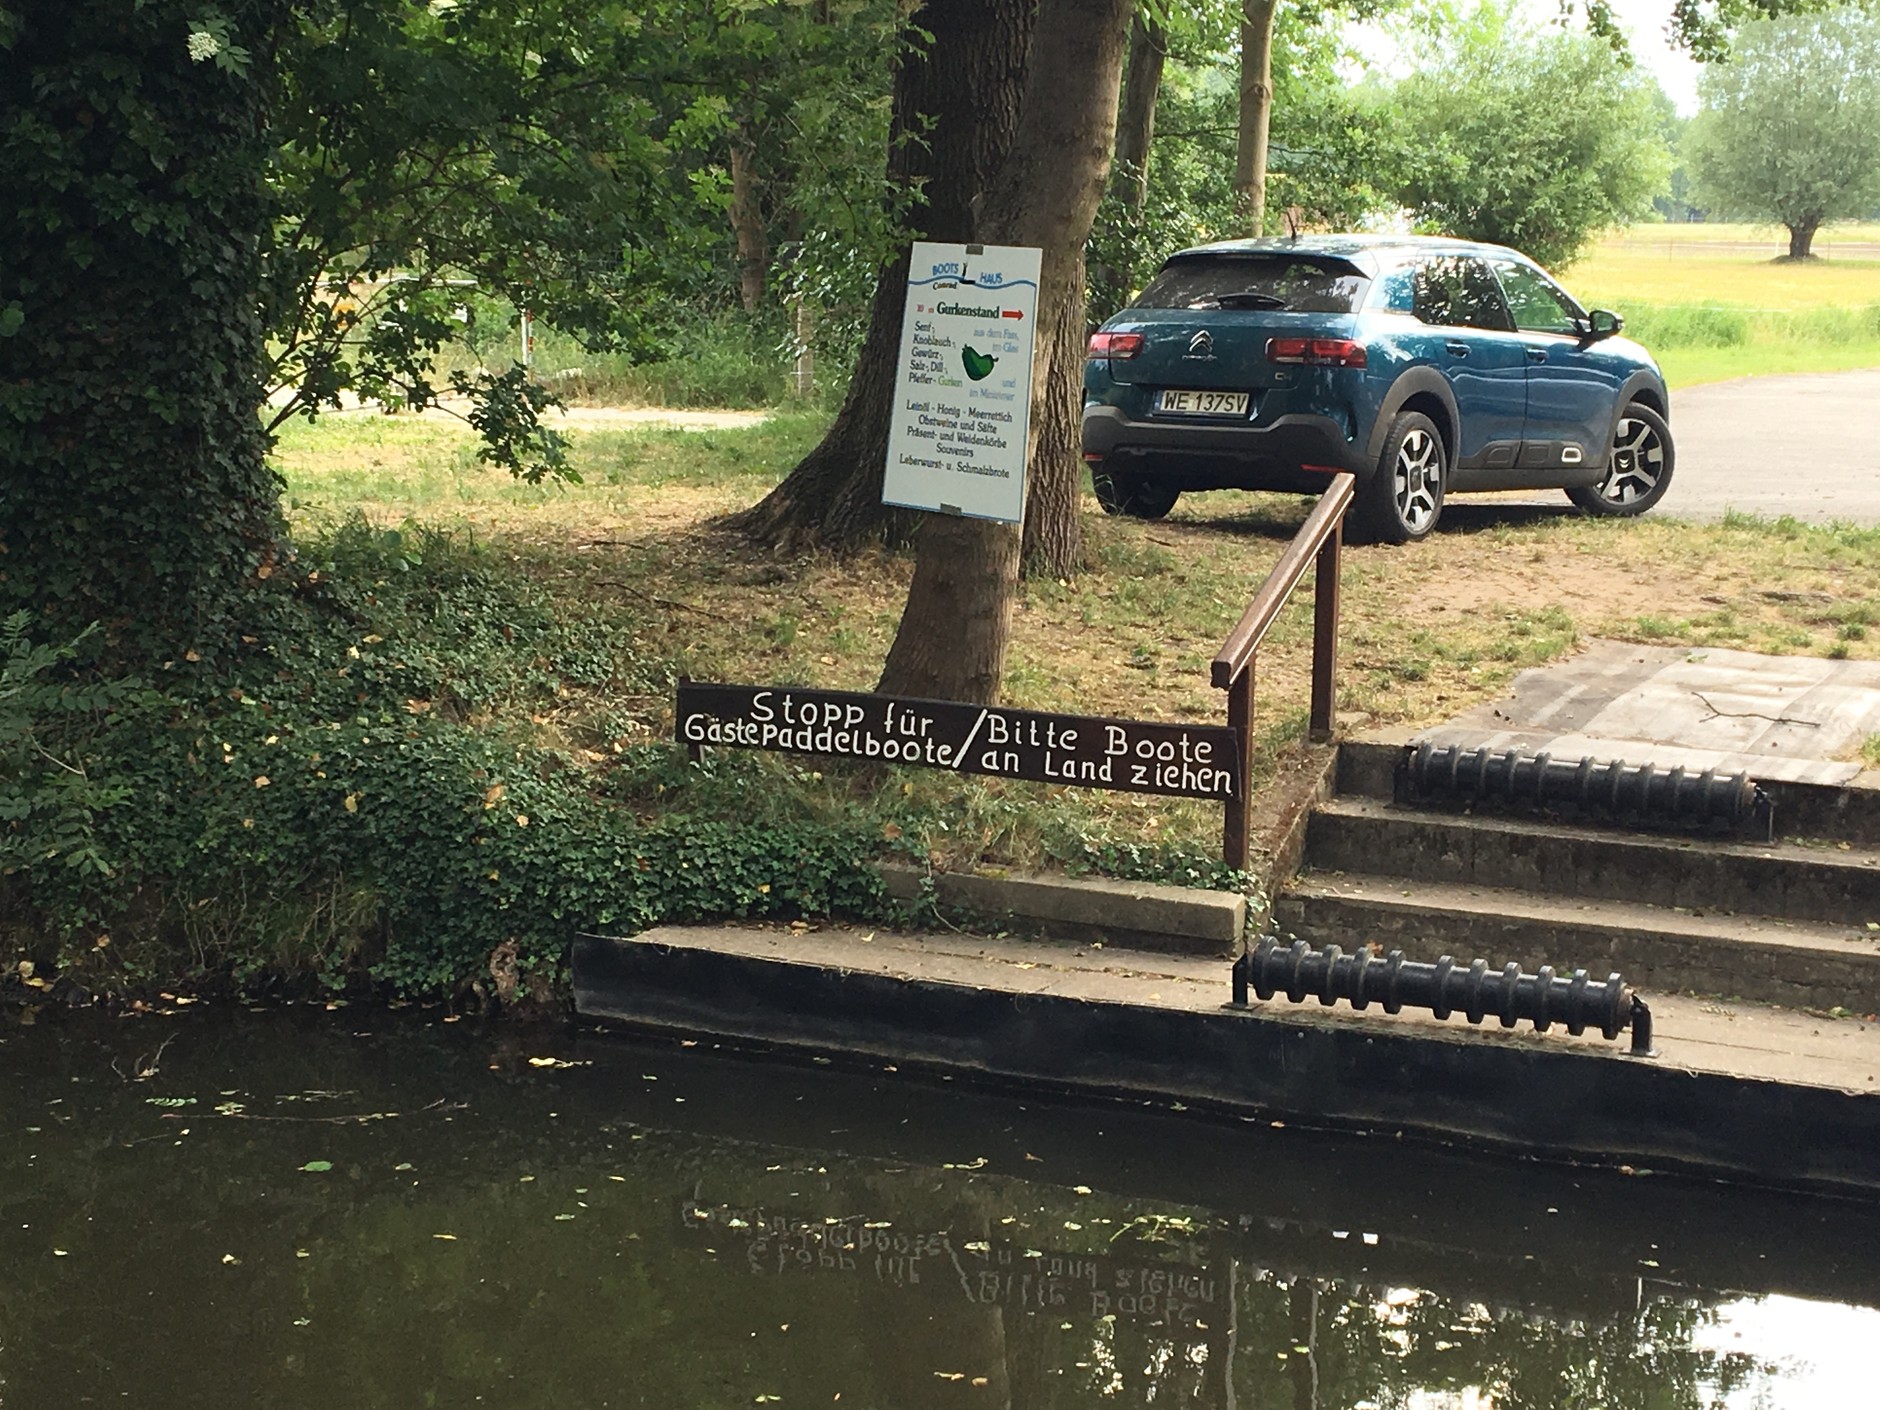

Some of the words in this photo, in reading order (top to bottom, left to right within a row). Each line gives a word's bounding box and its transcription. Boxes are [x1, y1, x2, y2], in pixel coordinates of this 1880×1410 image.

[932, 263, 959, 276] BOOTS
[980, 272, 1003, 284] HAUS
[933, 281, 958, 290] Conrad
[937, 301, 1000, 319] Gurkenstand
[1165, 392, 1189, 410] WE
[1195, 393, 1247, 412] 137SV
[918, 414, 958, 429] Obstweine
[960, 421, 975, 432] und
[977, 421, 997, 434] Säfte
[968, 407, 1012, 423] Meerrettich
[907, 425, 937, 439] Präsent-
[939, 432, 954, 442] und
[957, 432, 1007, 449] Weidenkörbe
[936, 442, 974, 458] Souvenirs
[900, 453, 944, 469] Leberwurst-
[957, 461, 1010, 478] Schmalzbrote
[751, 692, 864, 729] Stopp
[884, 703, 933, 737] für
[987, 714, 1078, 750] Bitte
[1104, 726, 1212, 764] Boote
[981, 750, 1020, 773] an
[1044, 751, 1112, 783] Land
[1130, 763, 1233, 795] ziehen
